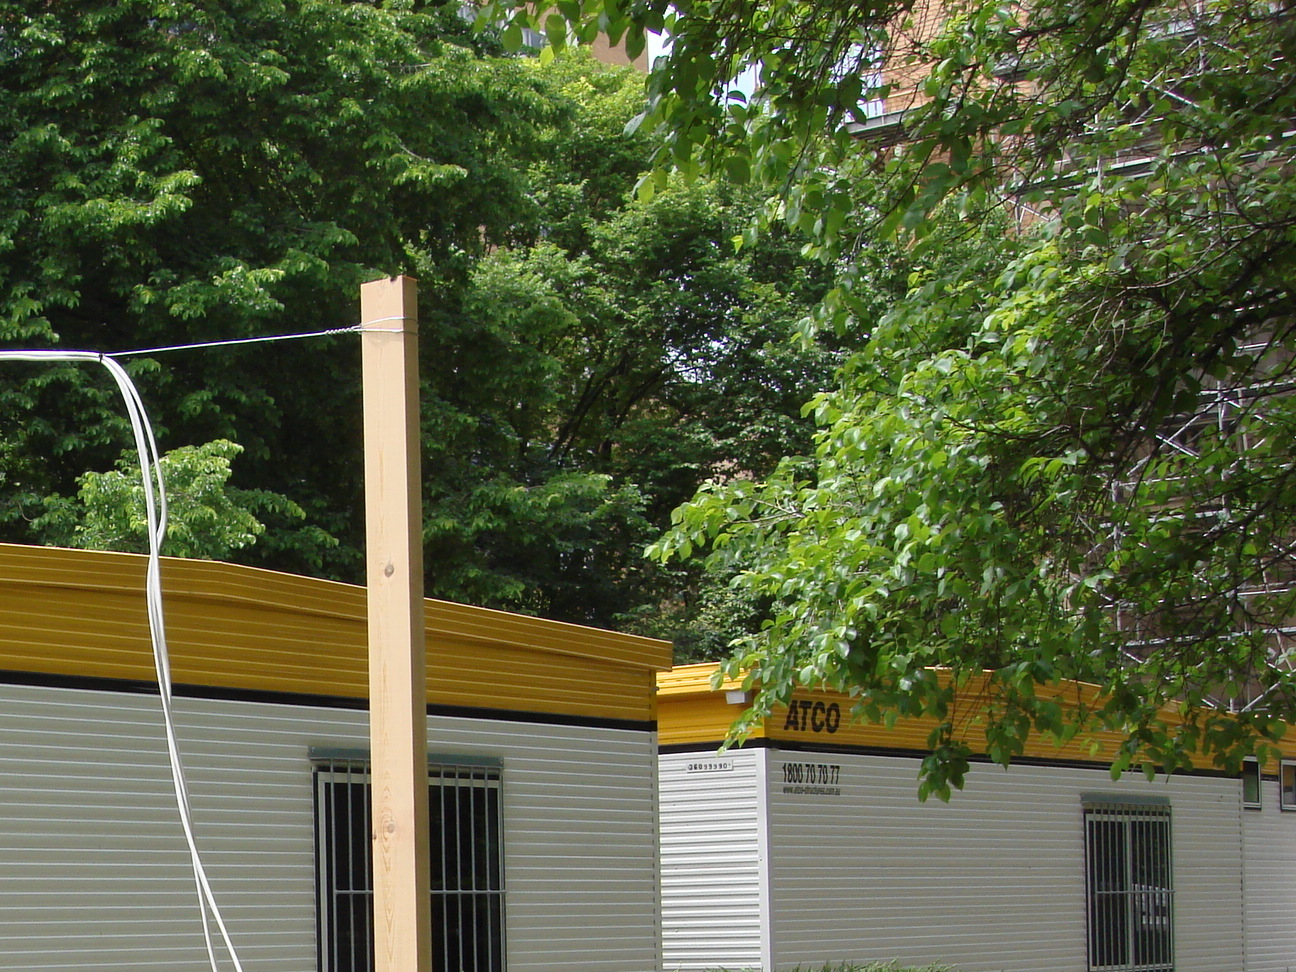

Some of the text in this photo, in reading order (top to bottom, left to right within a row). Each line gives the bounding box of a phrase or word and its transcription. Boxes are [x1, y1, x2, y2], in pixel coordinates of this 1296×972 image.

[784, 699, 841, 733] ATCO
[782, 762, 841, 785] 1800 70 70 77
